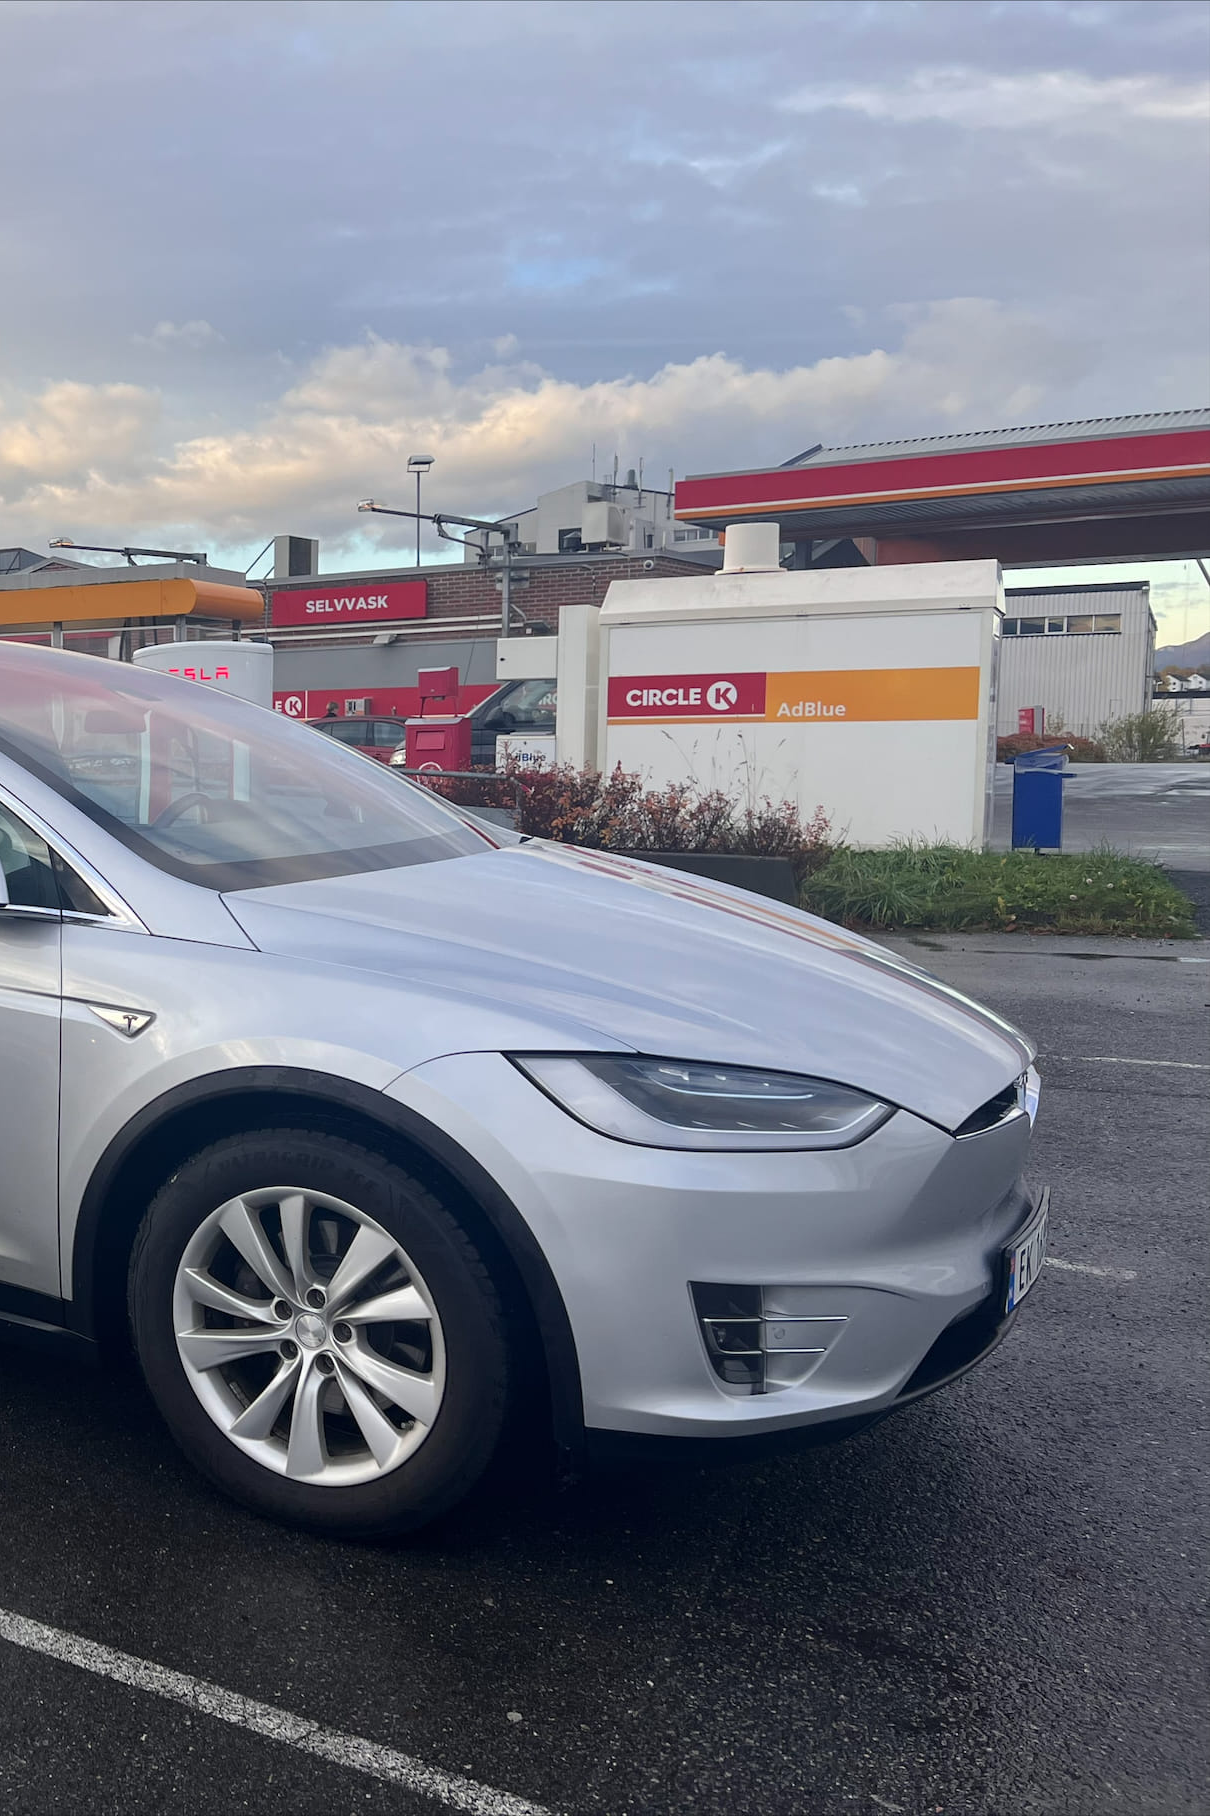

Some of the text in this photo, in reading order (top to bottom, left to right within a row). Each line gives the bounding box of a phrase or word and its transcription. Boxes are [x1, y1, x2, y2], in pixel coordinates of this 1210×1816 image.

[305, 594, 389, 614] SELVVASK
[625, 687, 702, 707] CIRCLE
[776, 701, 846, 717] AdBlue
[1019, 1240, 1034, 1292] EK
